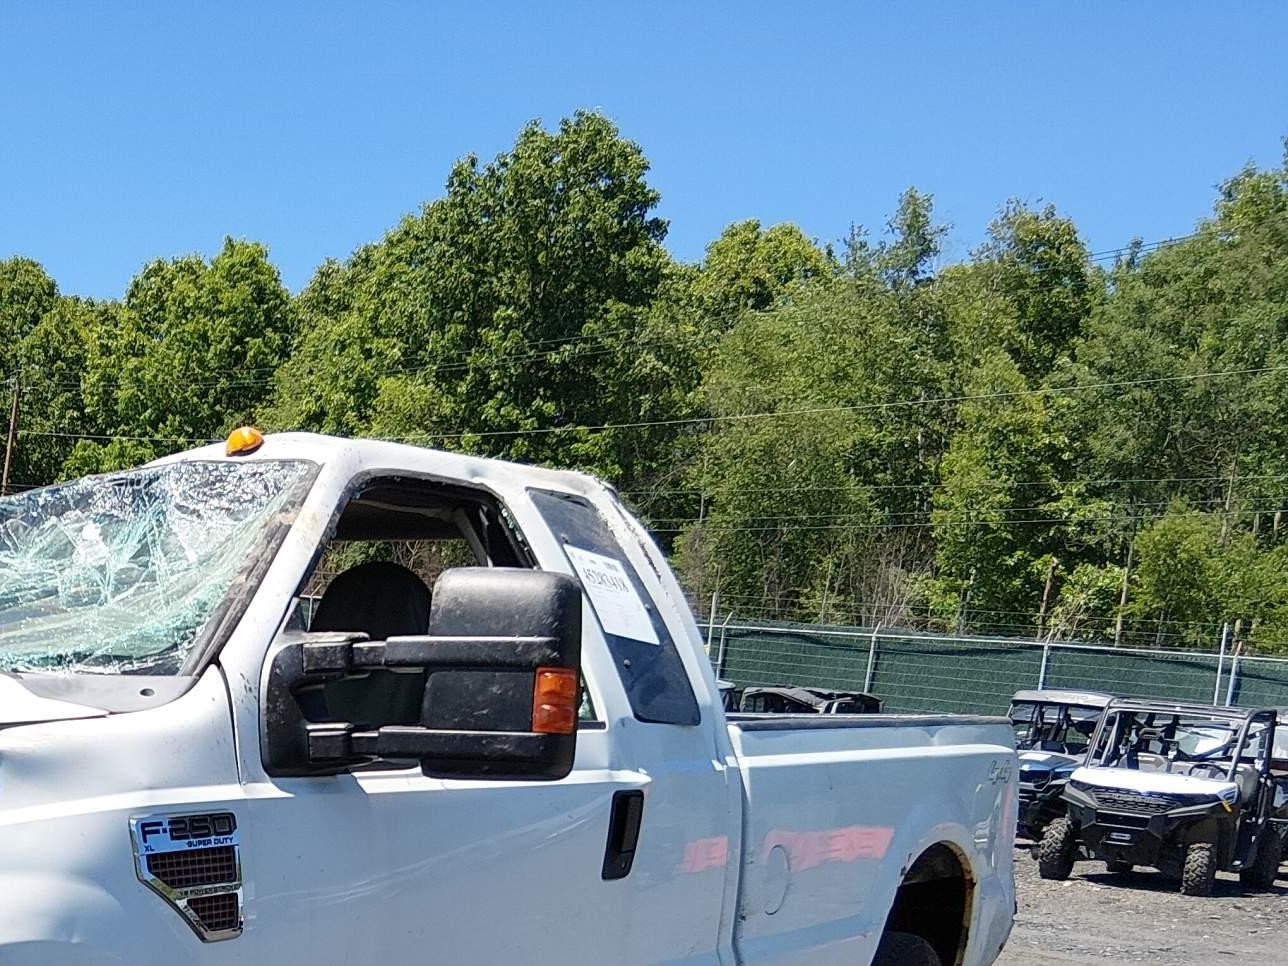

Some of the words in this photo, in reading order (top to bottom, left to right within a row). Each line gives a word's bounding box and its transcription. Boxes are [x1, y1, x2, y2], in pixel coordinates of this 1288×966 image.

[140, 812, 237, 843] F-250
[143, 844, 155, 852] XL
[186, 839, 213, 848] SUPER
[213, 836, 234, 846] DUTY
